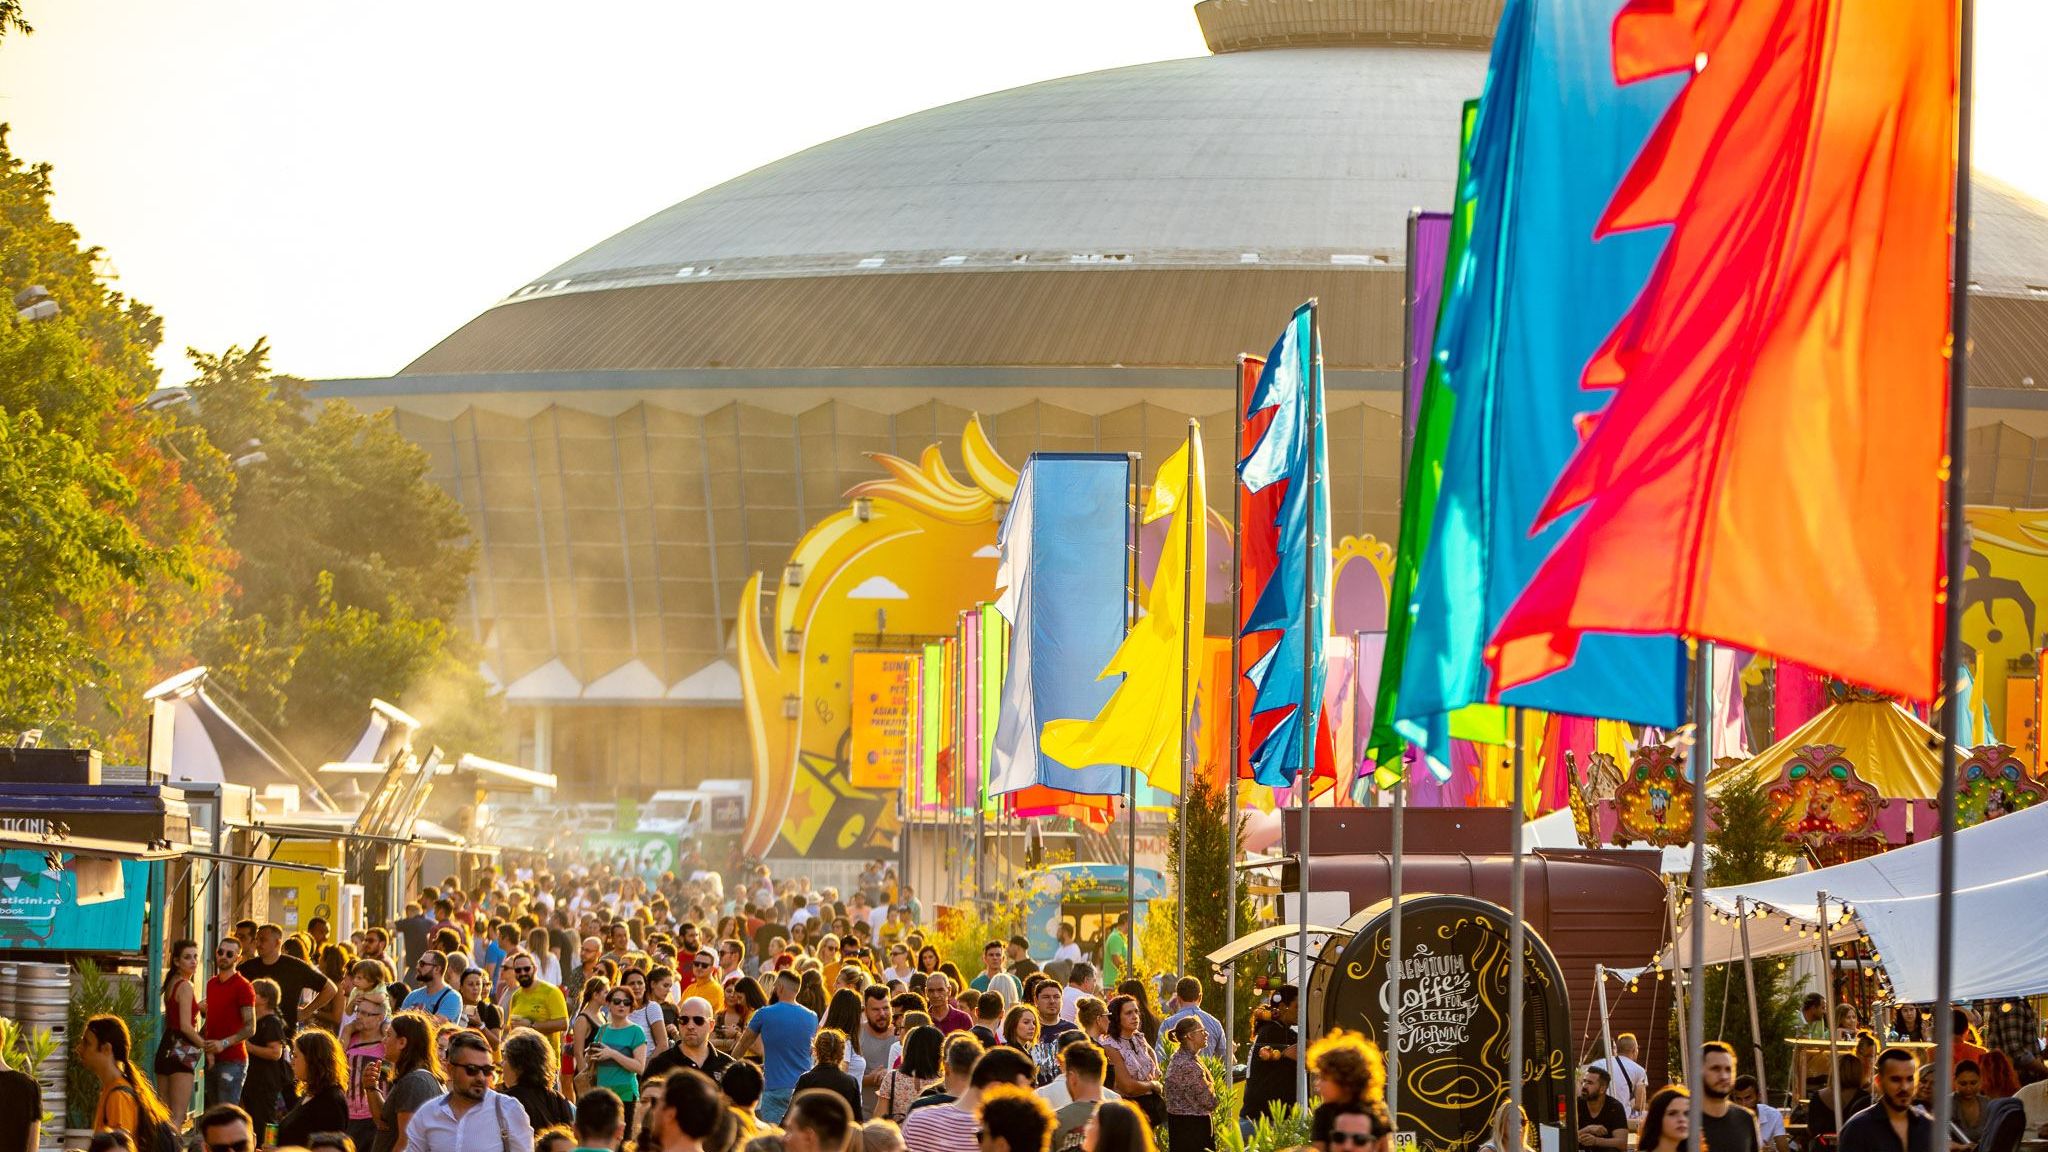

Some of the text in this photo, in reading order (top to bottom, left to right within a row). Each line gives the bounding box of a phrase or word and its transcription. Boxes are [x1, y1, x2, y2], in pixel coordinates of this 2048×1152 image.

[0, 818, 45, 834] TICINI
[1445, 995, 1463, 1008] FOR
[1421, 1010, 1465, 1023] better
